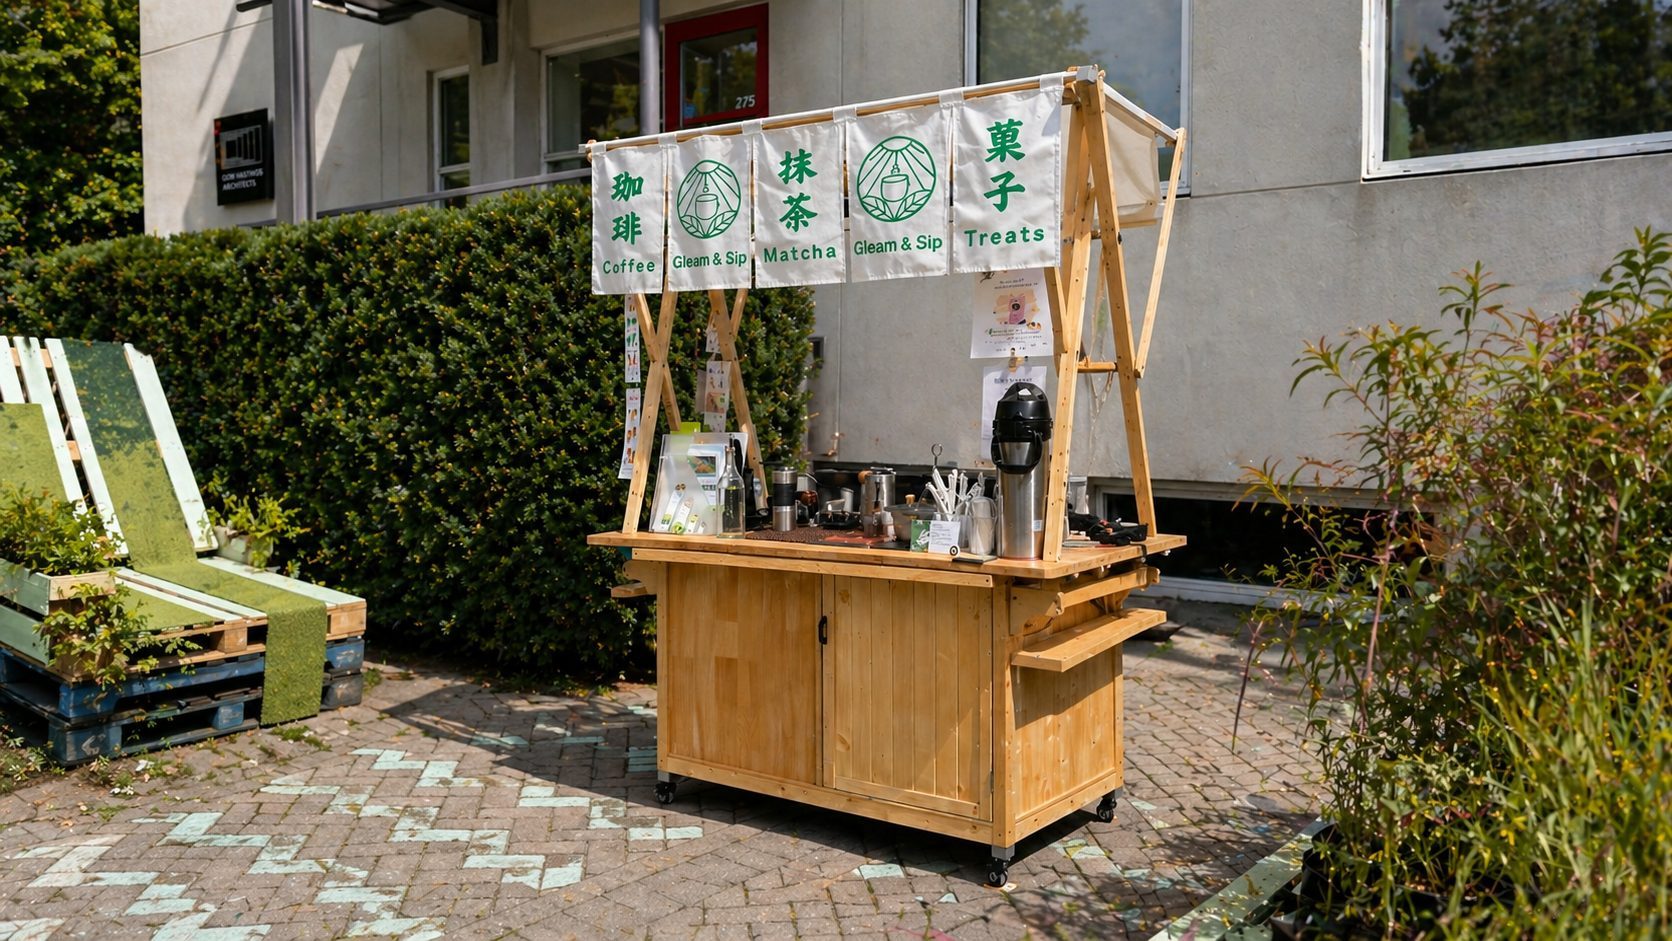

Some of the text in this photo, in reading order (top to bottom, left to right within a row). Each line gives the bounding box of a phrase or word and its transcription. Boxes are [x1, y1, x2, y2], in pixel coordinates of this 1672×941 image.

[735, 94, 756, 109] 275
[983, 118, 1026, 213] 菓子
[222, 179, 257, 191] ARCHITECTS
[778, 148, 818, 233] 抹茶
[611, 171, 644, 245] 珈琲
[854, 235, 943, 255] Gleam & Sip
[964, 226, 1045, 247] Treats
[672, 251, 747, 269] Gleam & Sip
[763, 244, 837, 263] Matcha
[602, 258, 655, 274] Coffee
